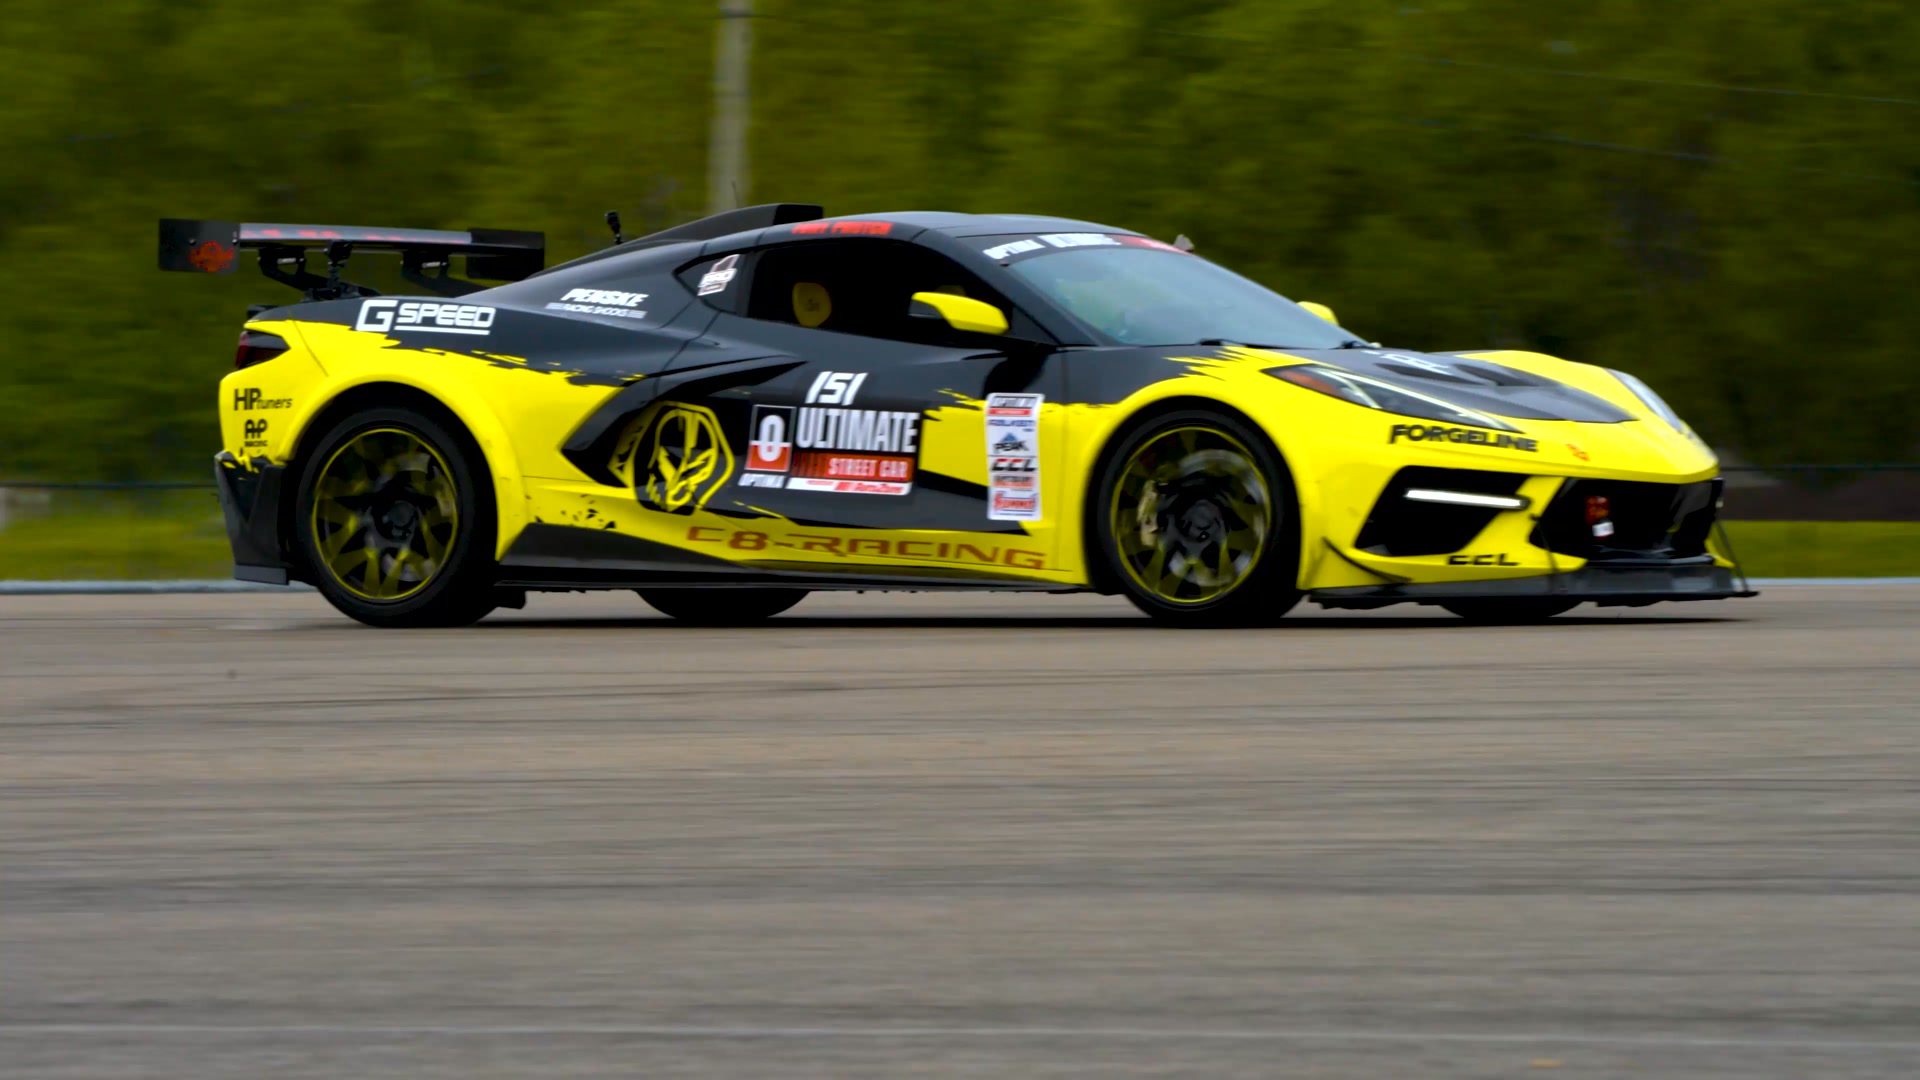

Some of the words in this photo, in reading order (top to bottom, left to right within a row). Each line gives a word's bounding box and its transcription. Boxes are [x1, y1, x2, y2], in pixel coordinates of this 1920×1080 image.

[560, 288, 649, 307] PENSKE
[396, 303, 496, 328] SPEED
[797, 407, 919, 453] ULTIMATE
[1388, 424, 1539, 452] FORGELINE
[828, 458, 877, 476] STREET
[879, 460, 908, 478] CAR
[1447, 553, 1521, 566] CCL
